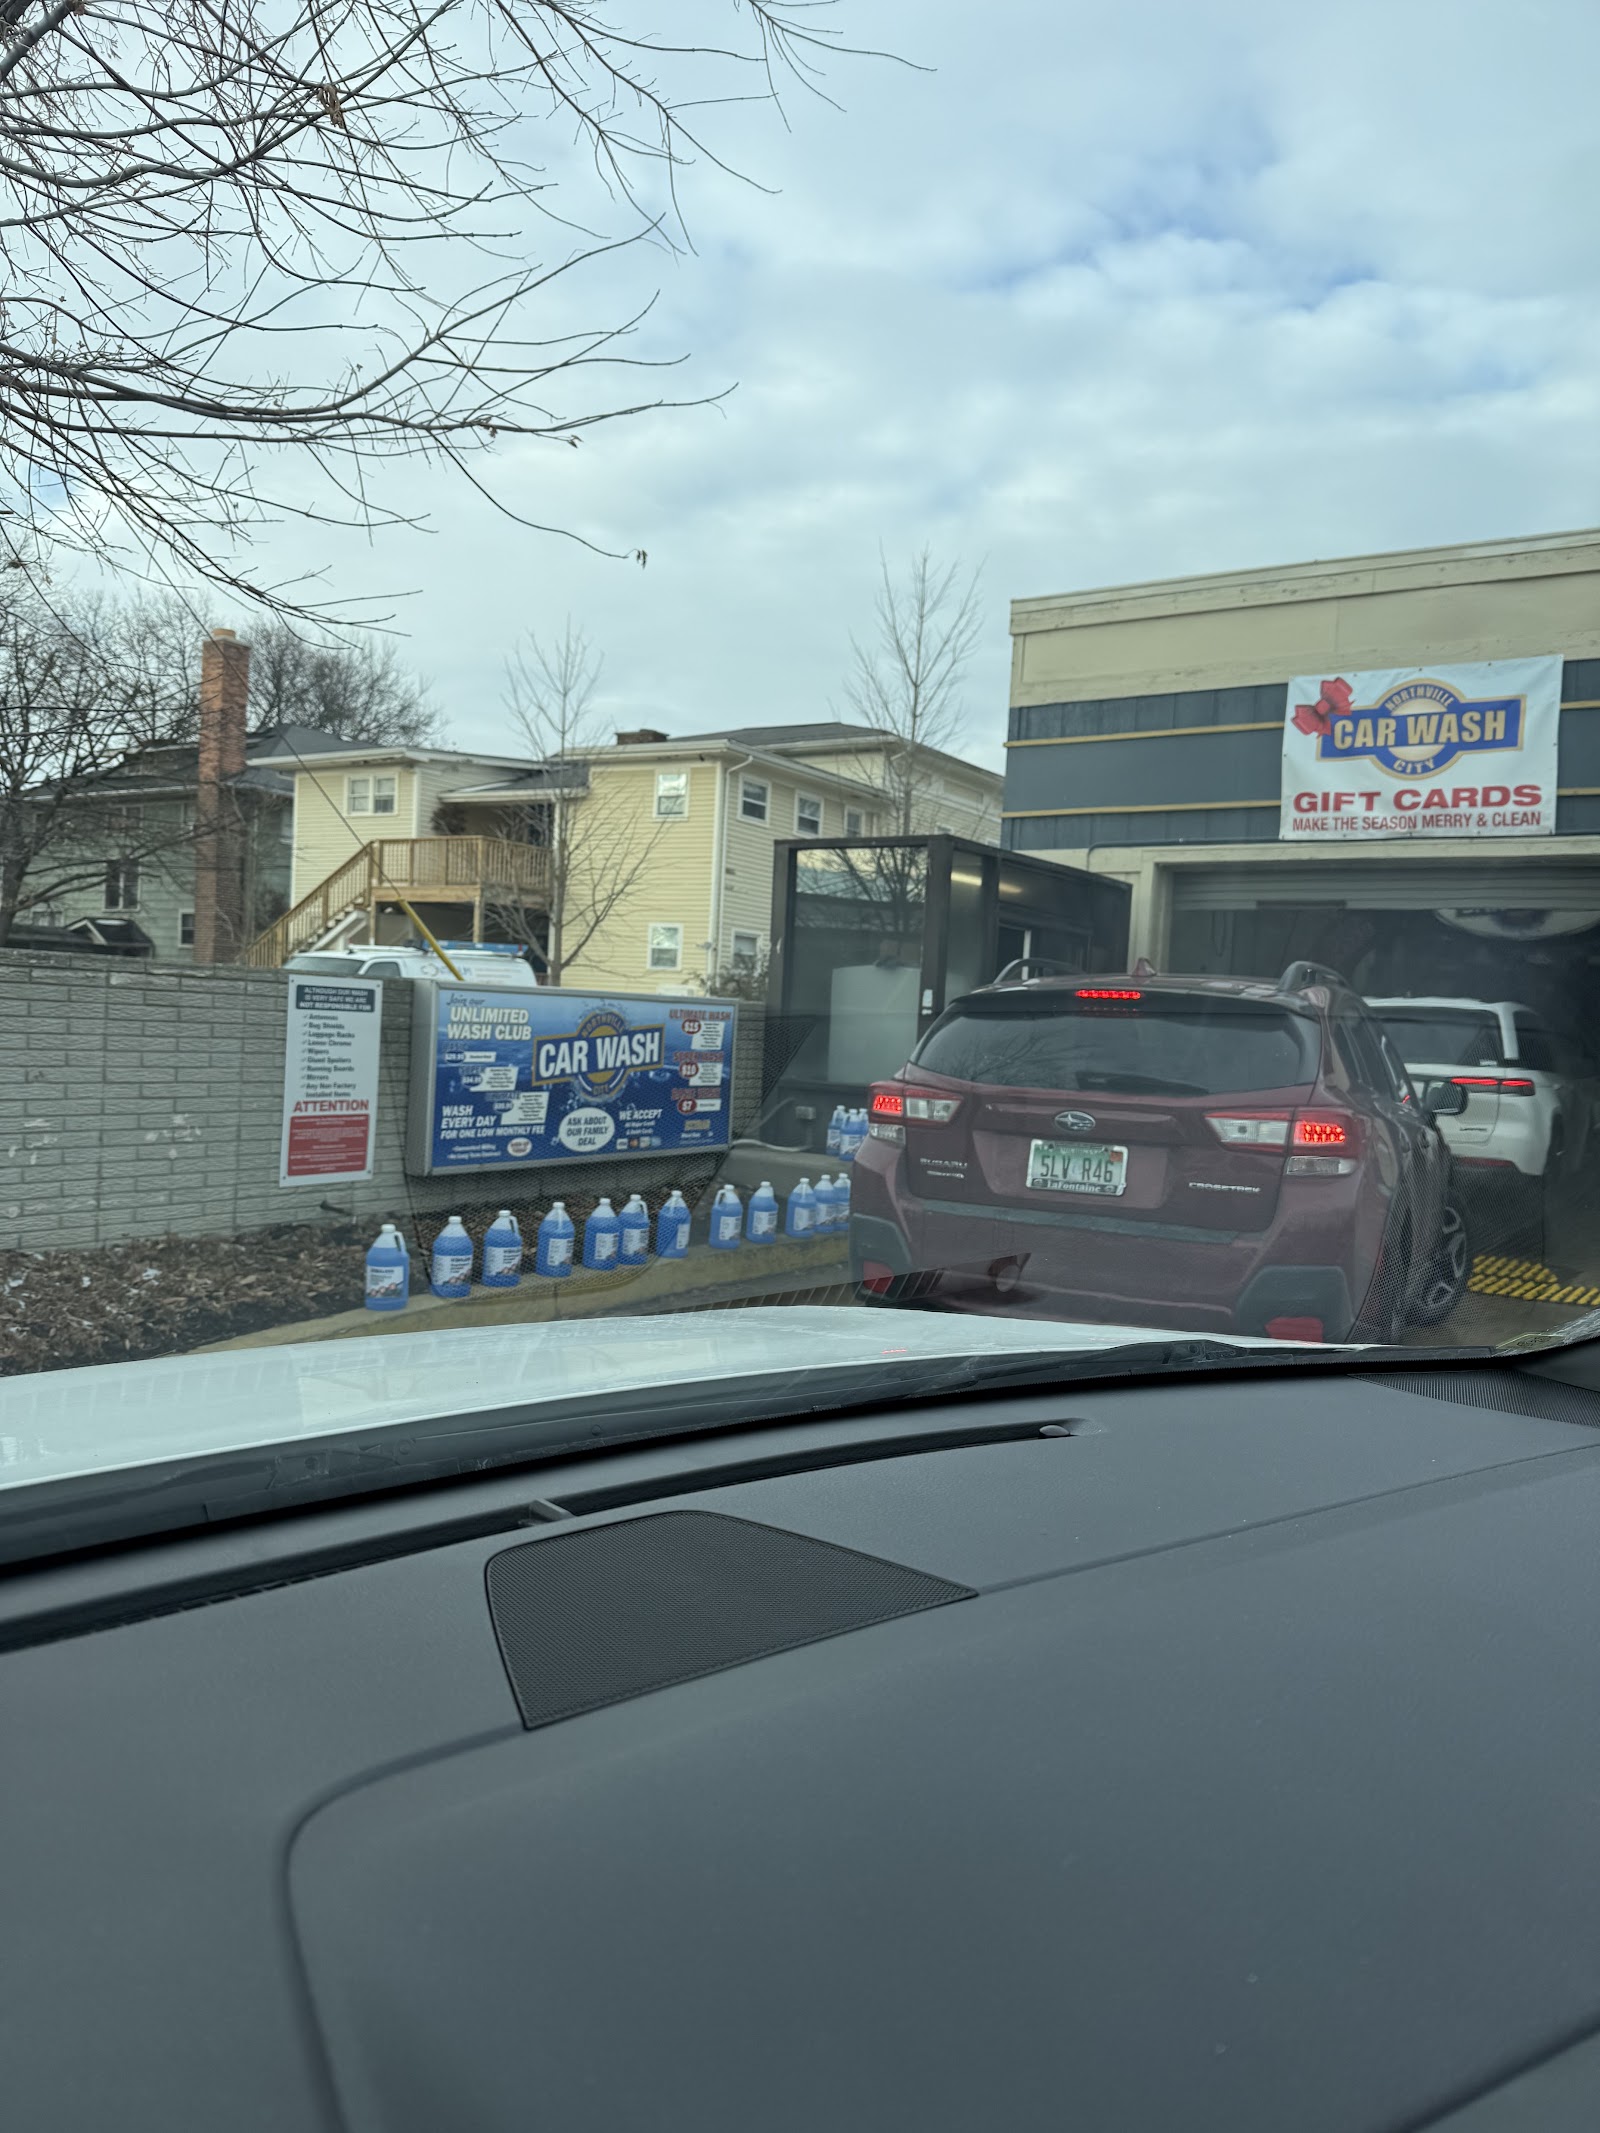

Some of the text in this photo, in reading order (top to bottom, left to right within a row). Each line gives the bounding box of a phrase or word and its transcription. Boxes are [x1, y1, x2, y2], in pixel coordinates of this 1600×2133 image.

[1385, 686, 1455, 711] NORTHVILLE
[1333, 709, 1506, 750] CAR WASH
[1393, 758, 1436, 774] CITY
[1293, 784, 1543, 813] GIFT CARDS
[1293, 811, 1542, 831] MAKE THE SEASON MERRY & CLEAN
[450, 1007, 529, 1024] UNLIMITED
[447, 1024, 532, 1040] WASH CLUB
[582, 1014, 625, 1037] NORTHVILLE
[539, 1040, 589, 1078] CAR
[596, 1031, 660, 1070] WASH
[293, 1099, 369, 1113] ATTENTION
[442, 1105, 474, 1117] WASH
[566, 1116, 607, 1126] ASK ABOUT
[619, 1109, 663, 1120] WE ACCEPT
[441, 1115, 497, 1129] EVERY DAY
[440, 1125, 546, 1139] FOR ONE LOW MONTHLY FEE
[566, 1126, 609, 1136] OUR FAMILY
[578, 1137, 596, 1146] DEAL
[920, 1158, 968, 1169] SUBARU
[1040, 1155, 1114, 1183] 5LV R46
[1047, 1180, 1101, 1192] LaFontaine
[1189, 1182, 1260, 1193] CROSSTREK
